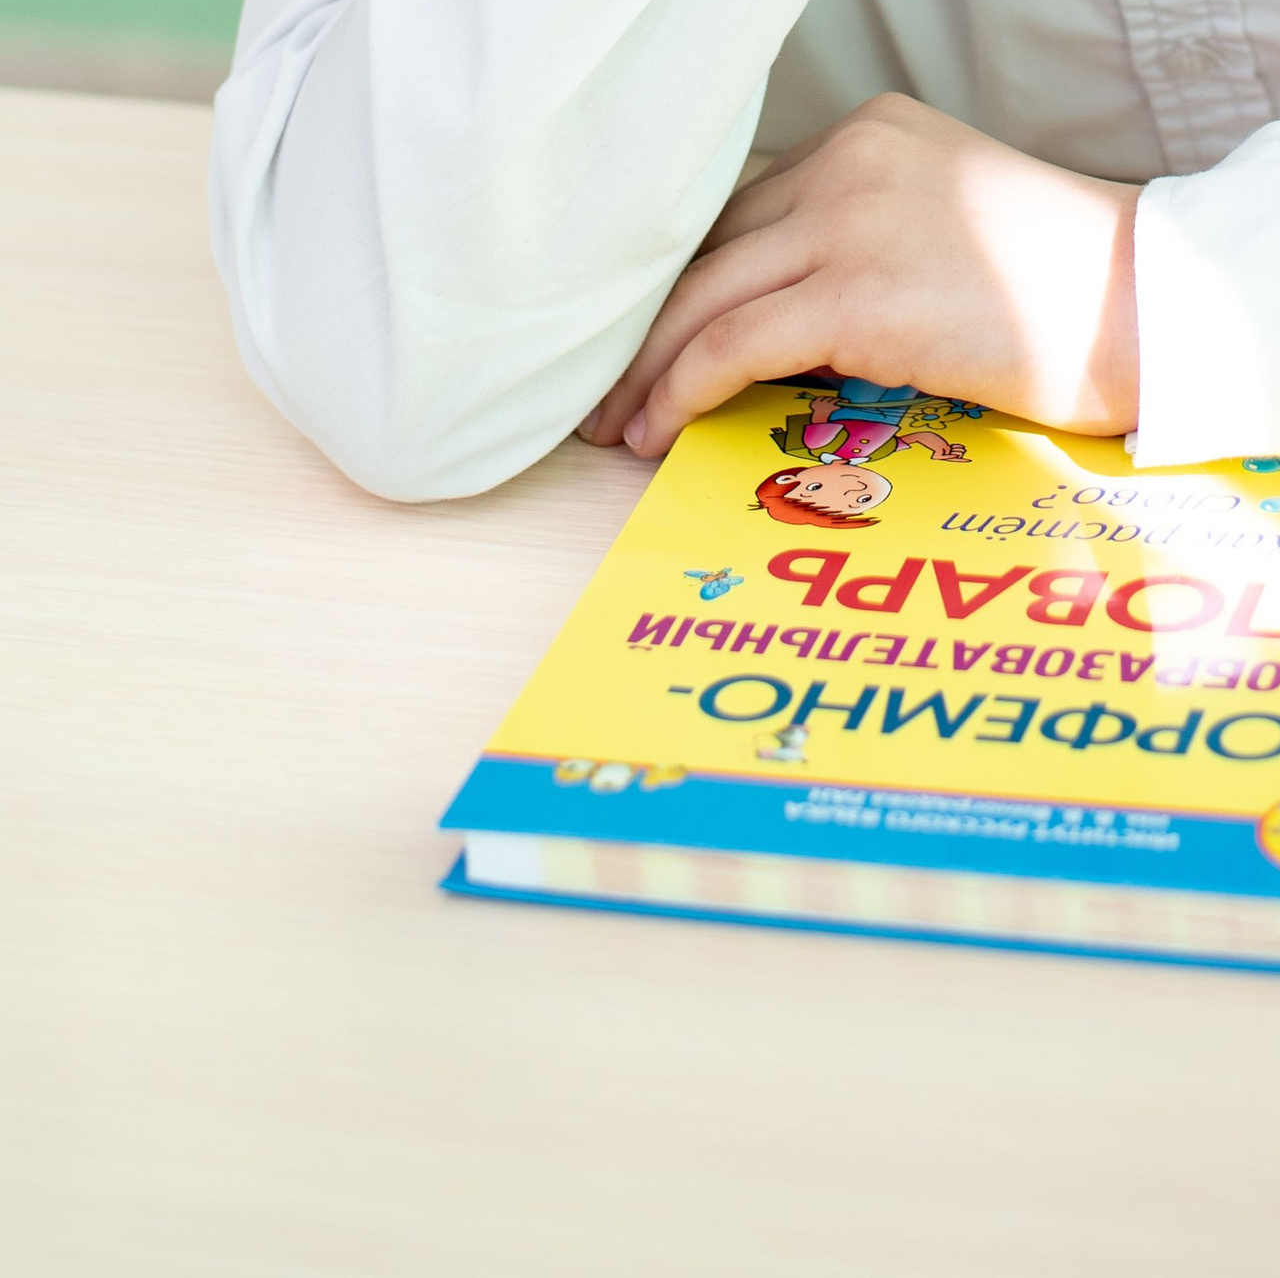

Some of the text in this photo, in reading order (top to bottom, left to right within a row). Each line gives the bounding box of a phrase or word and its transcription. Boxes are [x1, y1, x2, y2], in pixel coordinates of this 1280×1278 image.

[1032, 485, 1241, 513] слово?
[940, 511, 1181, 557] растёт
[784, 800, 881, 829] ЯЗЫКА
[885, 810, 1028, 840] РУССКОГО
